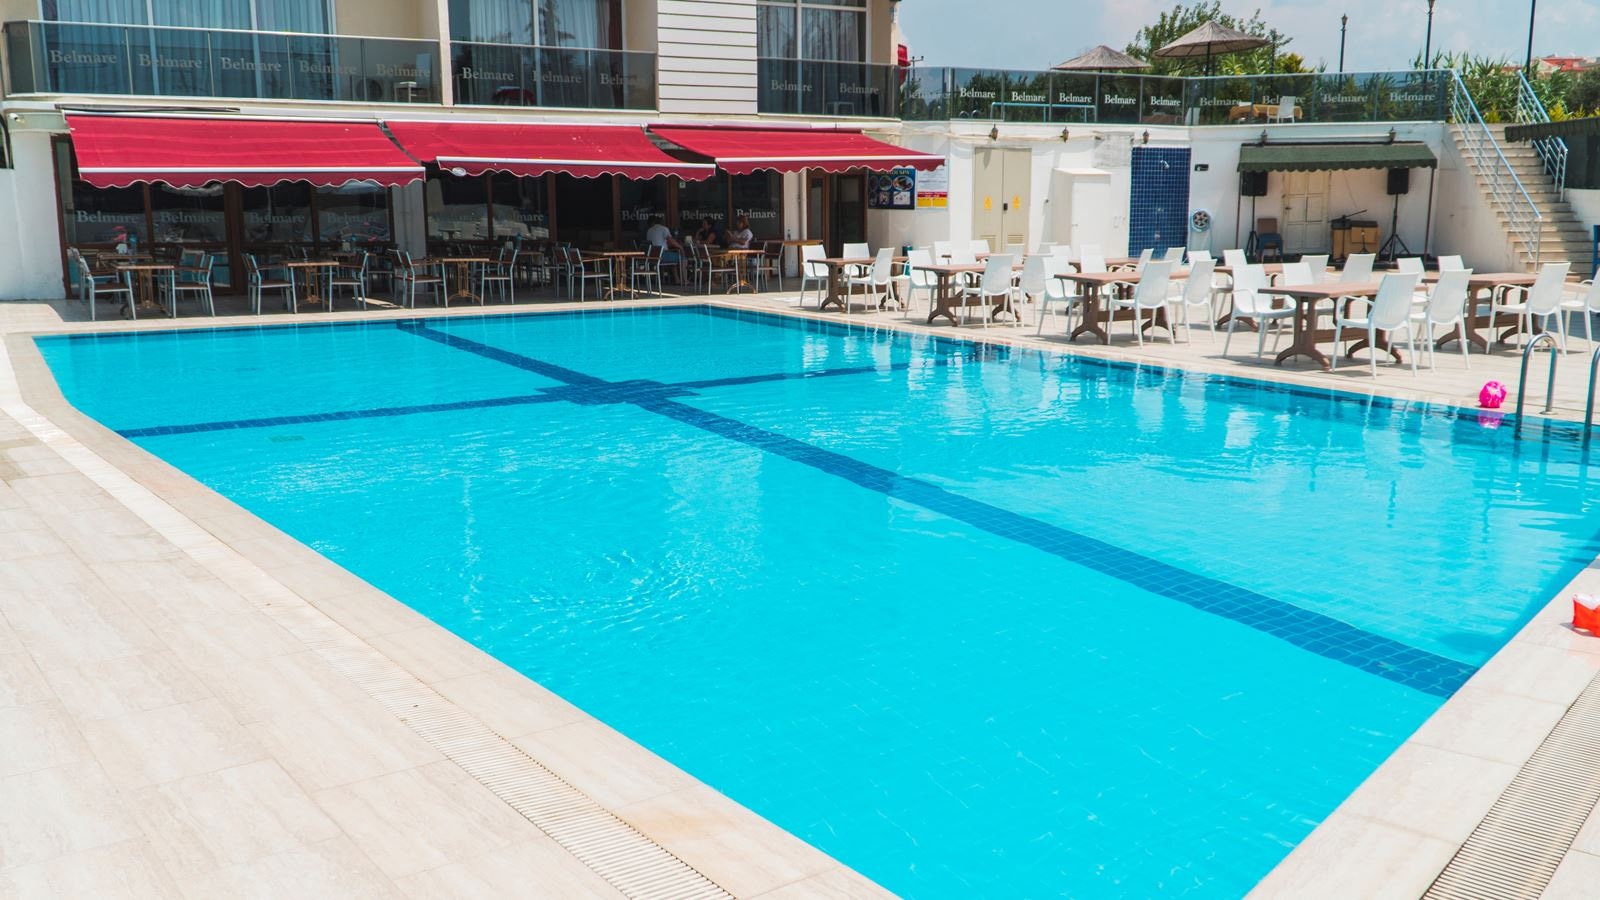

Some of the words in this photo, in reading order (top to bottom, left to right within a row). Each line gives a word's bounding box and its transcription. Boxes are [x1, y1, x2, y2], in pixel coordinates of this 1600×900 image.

[50, 50, 118, 64] Belmare
[375, 63, 432, 79] Belmare
[462, 66, 514, 81] Belmare
[771, 79, 812, 92] Belmre
[839, 82, 880, 95] Belmare
[960, 87, 996, 99] Belmare
[1011, 91, 1046, 103] Belmare
[1059, 92, 1093, 104] Belmare
[1322, 93, 1369, 103] Belmare
[1389, 91, 1436, 102] Belmare
[1104, 94, 1137, 106] Belmare
[1150, 95, 1182, 107] Belmare
[1262, 94, 1306, 106] Belre
[76, 210, 139, 224] Belmare
[159, 211, 221, 223] Belmare
